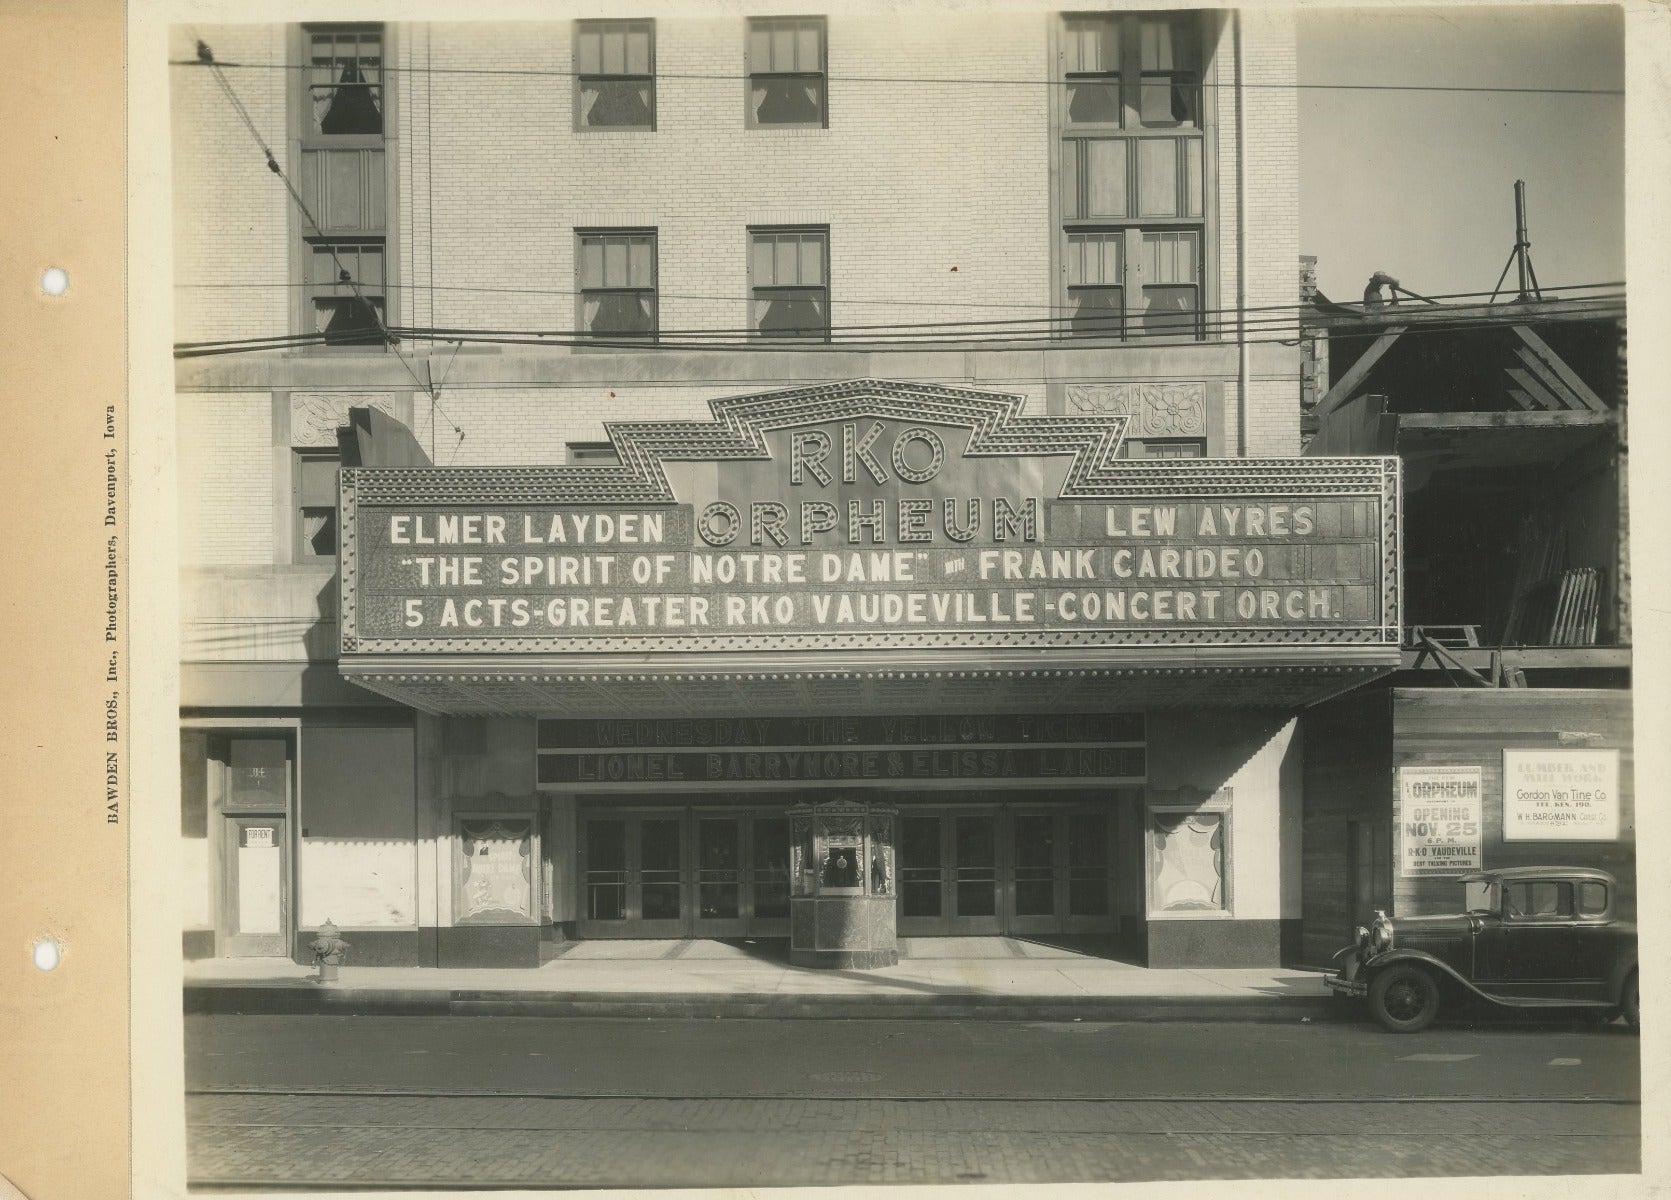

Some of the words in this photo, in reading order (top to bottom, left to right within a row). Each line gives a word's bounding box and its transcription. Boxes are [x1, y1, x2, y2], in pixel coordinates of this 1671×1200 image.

[103, 405, 115, 439] Iowa
[790, 420, 946, 487] RKO
[104, 448, 117, 526] Davenport,
[390, 514, 506, 544] ELMER
[524, 513, 664, 544] LAYDEN
[698, 496, 1038, 547] ORPHEUM
[1106, 507, 1177, 537] LEW
[1198, 505, 1315, 536] AYRES
[501, 556, 615, 586] SPIRIT
[632, 555, 672, 585] OF
[693, 553, 806, 584] NOTRE
[979, 548, 1097, 580] FRANK
[1113, 547, 1265, 579] CARIDEO
[105, 535, 118, 642] Photographers,
[405, 598, 423, 627] 5
[441, 595, 710, 627] ACTS-GREATER
[726, 595, 795, 625] RKO
[813, 592, 1034, 625] VAUDEVILLE
[1237, 588, 1342, 620] ORCH.
[105, 651, 118, 682] Inc.,
[105, 691, 118, 742] BROS.,
[596, 718, 770, 746] WEDNESDAY
[578, 754, 684, 780] LIONEL
[706, 752, 880, 778] BARRYMORE
[887, 751, 905, 777] &
[912, 751, 1017, 776] ELISSA
[1040, 749, 1129, 775] LANDI
[106, 752, 119, 824] BAWDEN
[1413, 781, 1478, 799] ORPHEUM
[1516, 788, 1550, 800] Gordon
[1551, 789, 1569, 800] Van
[1570, 789, 1592, 800] Tine
[1413, 808, 1470, 822] OPENING
[1446, 822, 1478, 837] 25
[1532, 812, 1577, 821] BARGMANN
[1432, 847, 1477, 857] VAUDEVILLE
